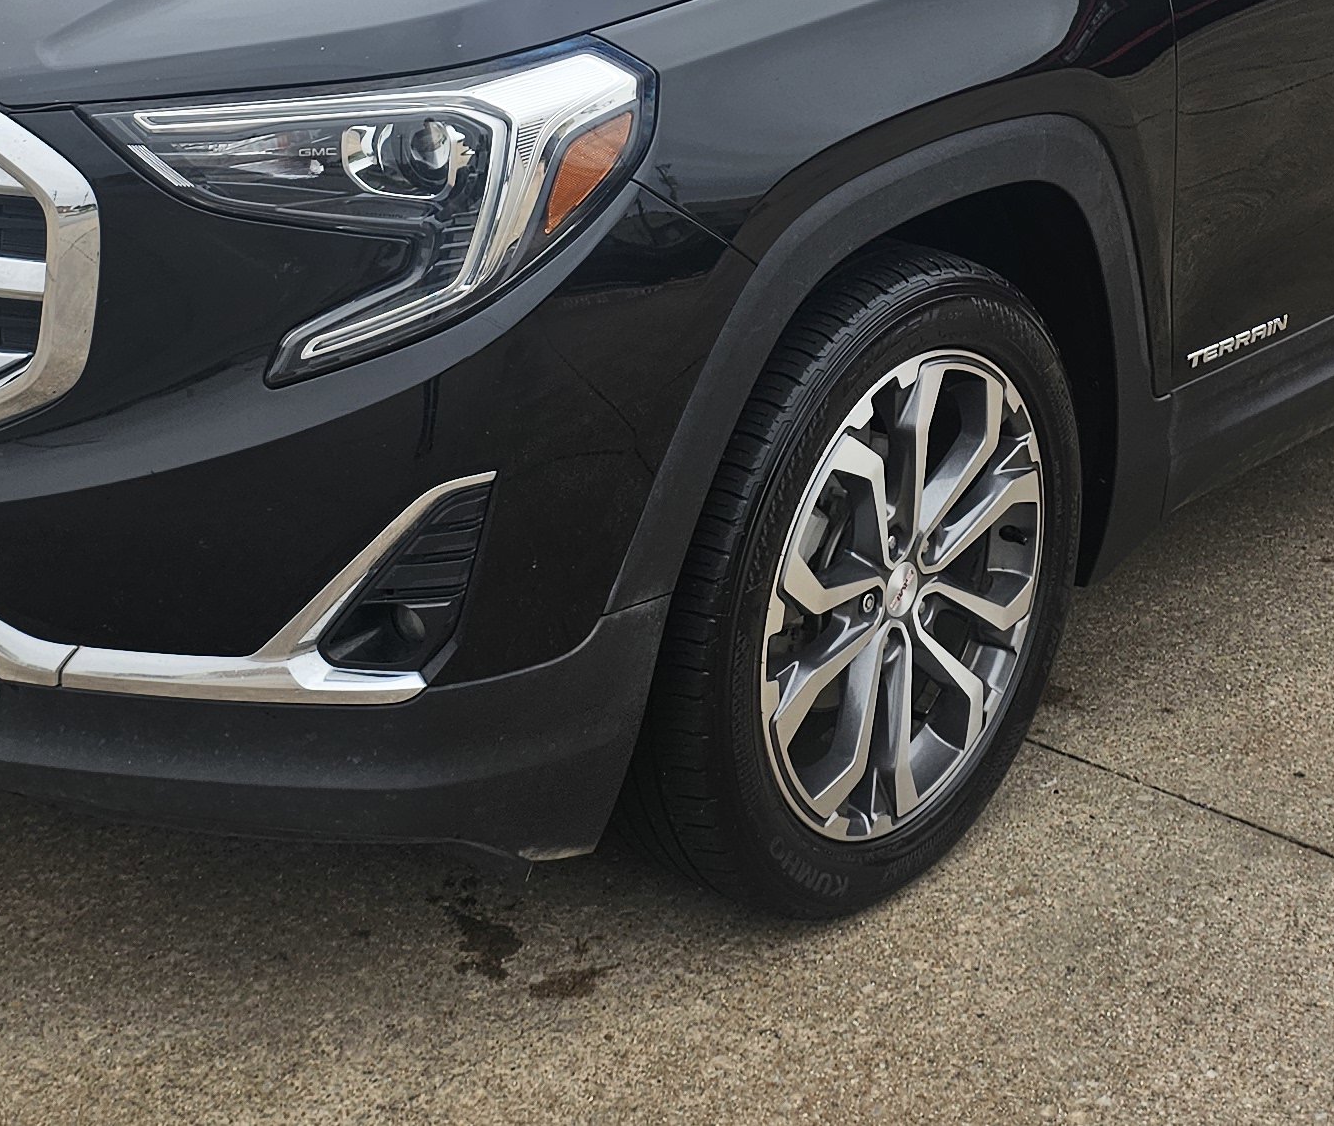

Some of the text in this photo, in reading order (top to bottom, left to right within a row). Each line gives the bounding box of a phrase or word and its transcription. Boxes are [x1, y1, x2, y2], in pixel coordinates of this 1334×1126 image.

[298, 147, 338, 157] GMC
[1186, 313, 1289, 369] TERRAIN
[769, 835, 850, 898] KUMHO
